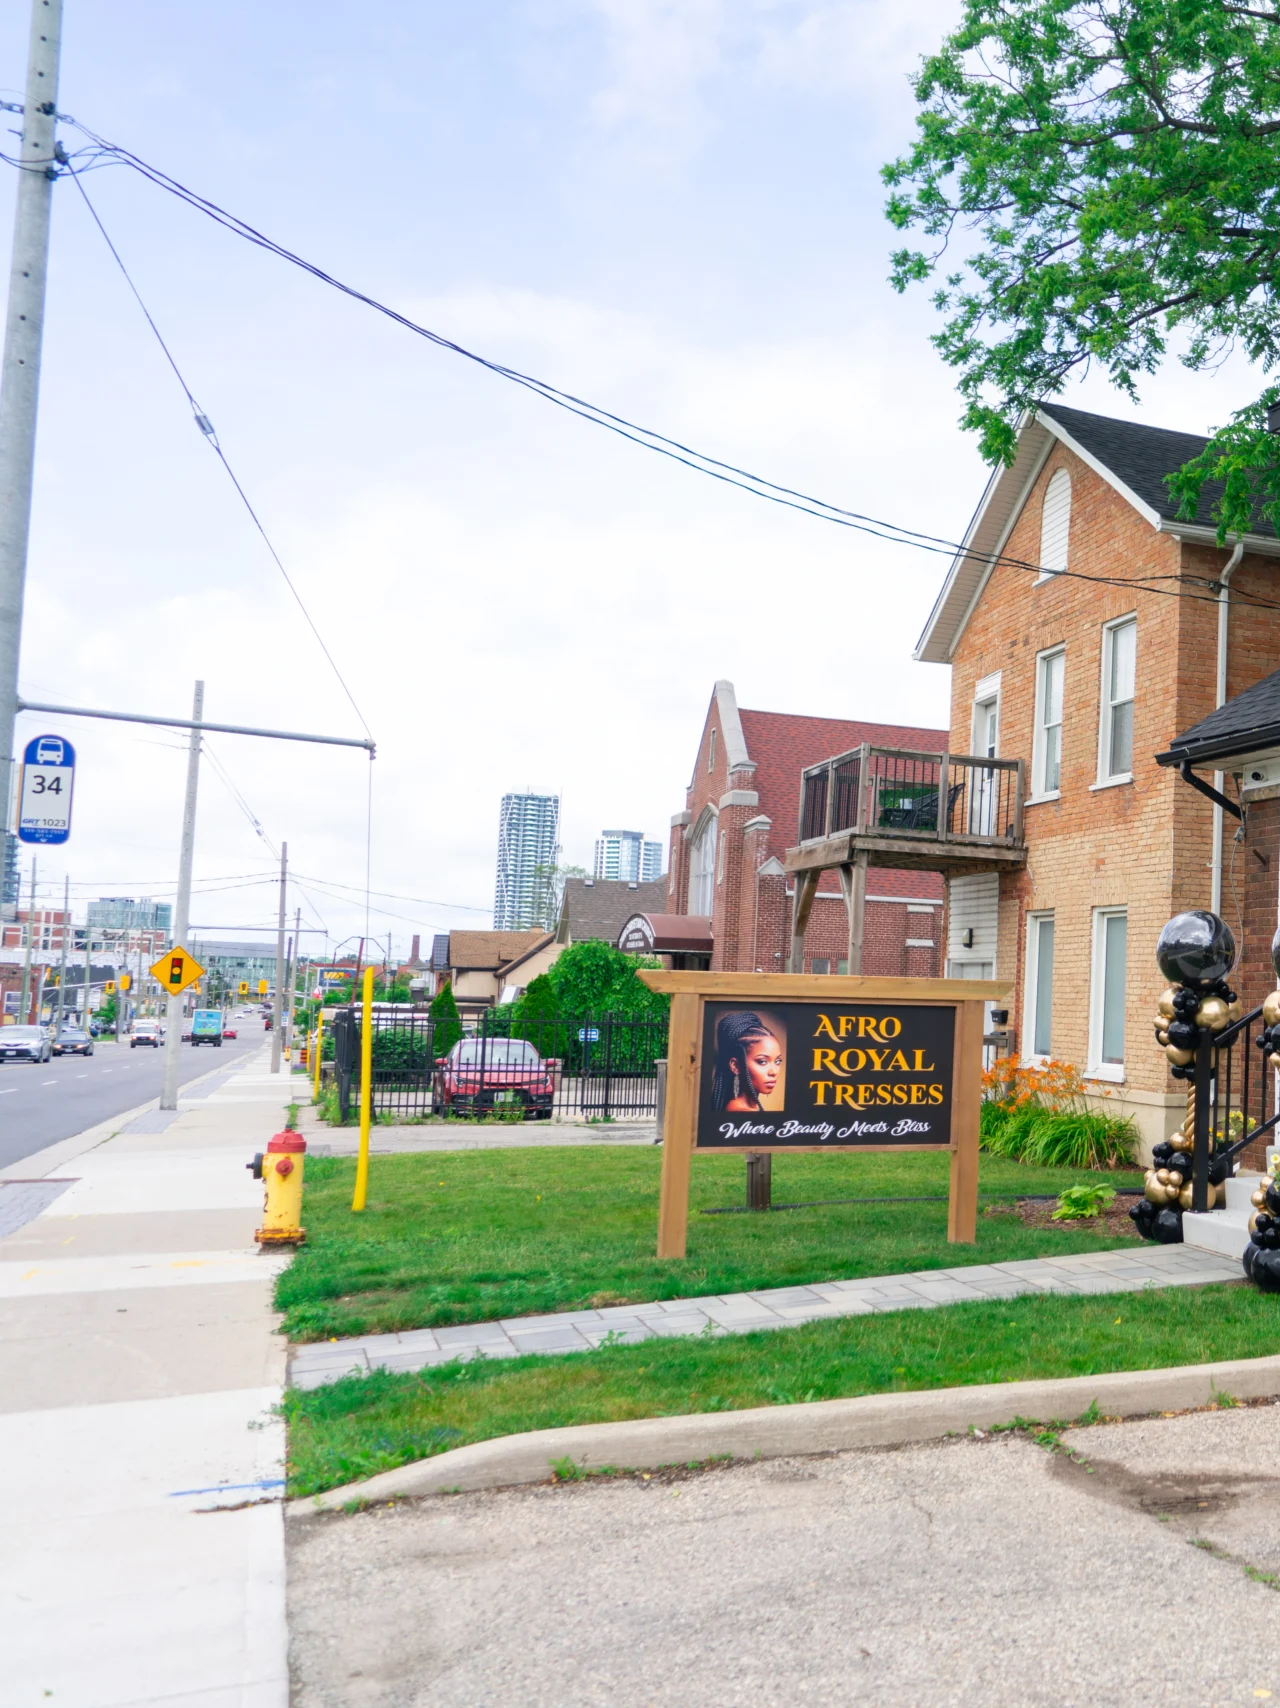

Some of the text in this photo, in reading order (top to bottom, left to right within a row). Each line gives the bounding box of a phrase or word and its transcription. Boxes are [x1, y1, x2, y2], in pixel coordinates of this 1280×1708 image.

[32, 775, 63, 795] 34
[42, 818, 66, 827] 1023
[812, 1014, 902, 1043] AFRO
[811, 1048, 935, 1077] ROYAL
[809, 1081, 944, 1111] TRESSES
[719, 1118, 932, 1140] Where Beauty Meets Bliss
